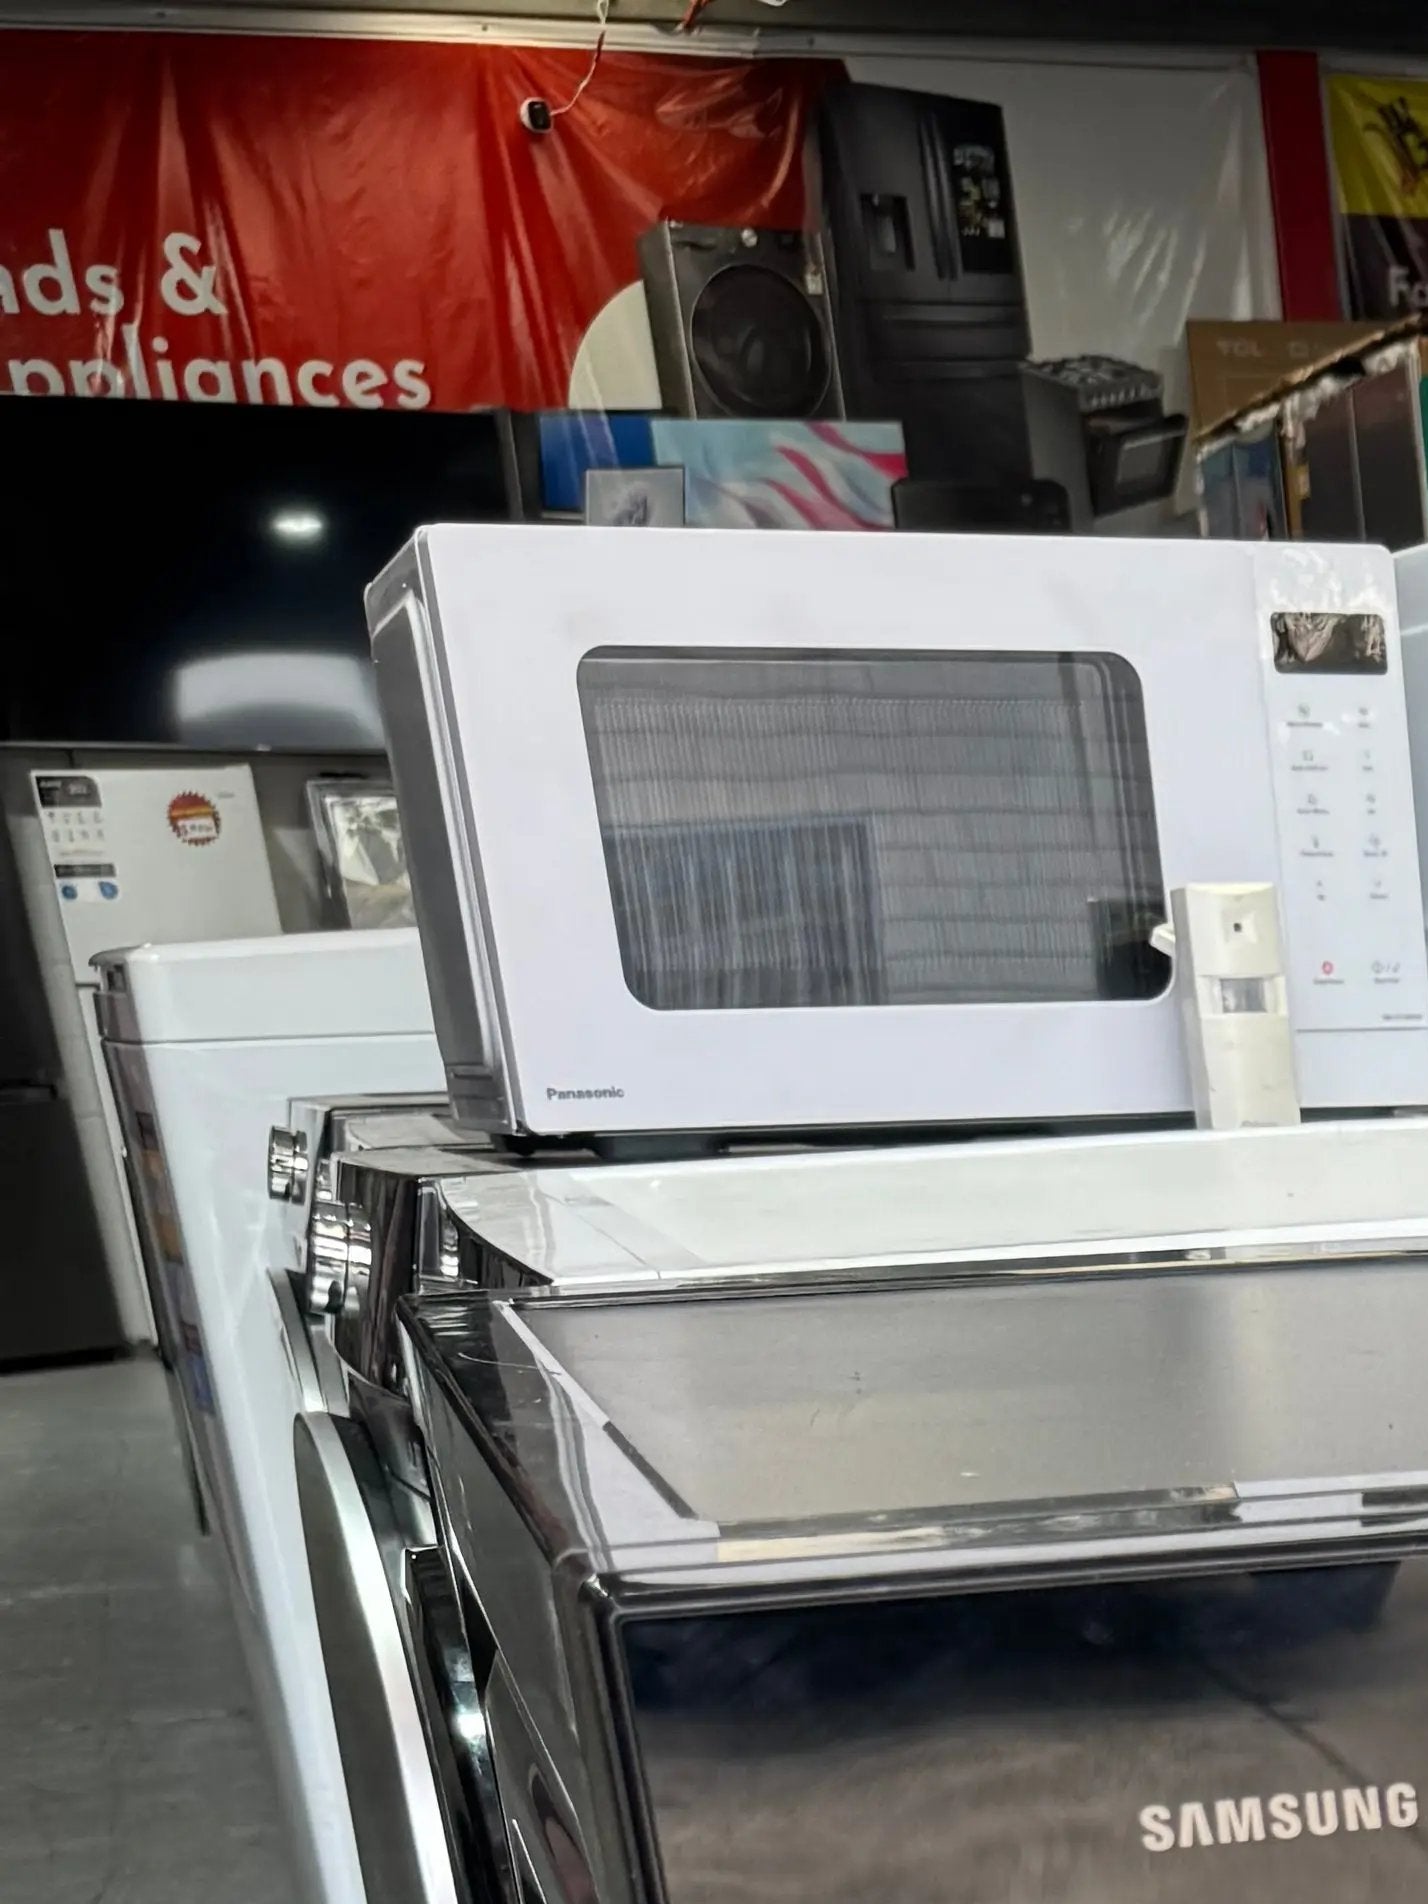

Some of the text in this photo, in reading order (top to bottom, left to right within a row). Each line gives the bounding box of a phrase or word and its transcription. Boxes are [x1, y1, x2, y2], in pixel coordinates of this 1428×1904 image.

[161, 232, 228, 316] &
[546, 1086, 625, 1101] Panasonic
[1140, 1782, 1419, 1852] SAMSUNG
